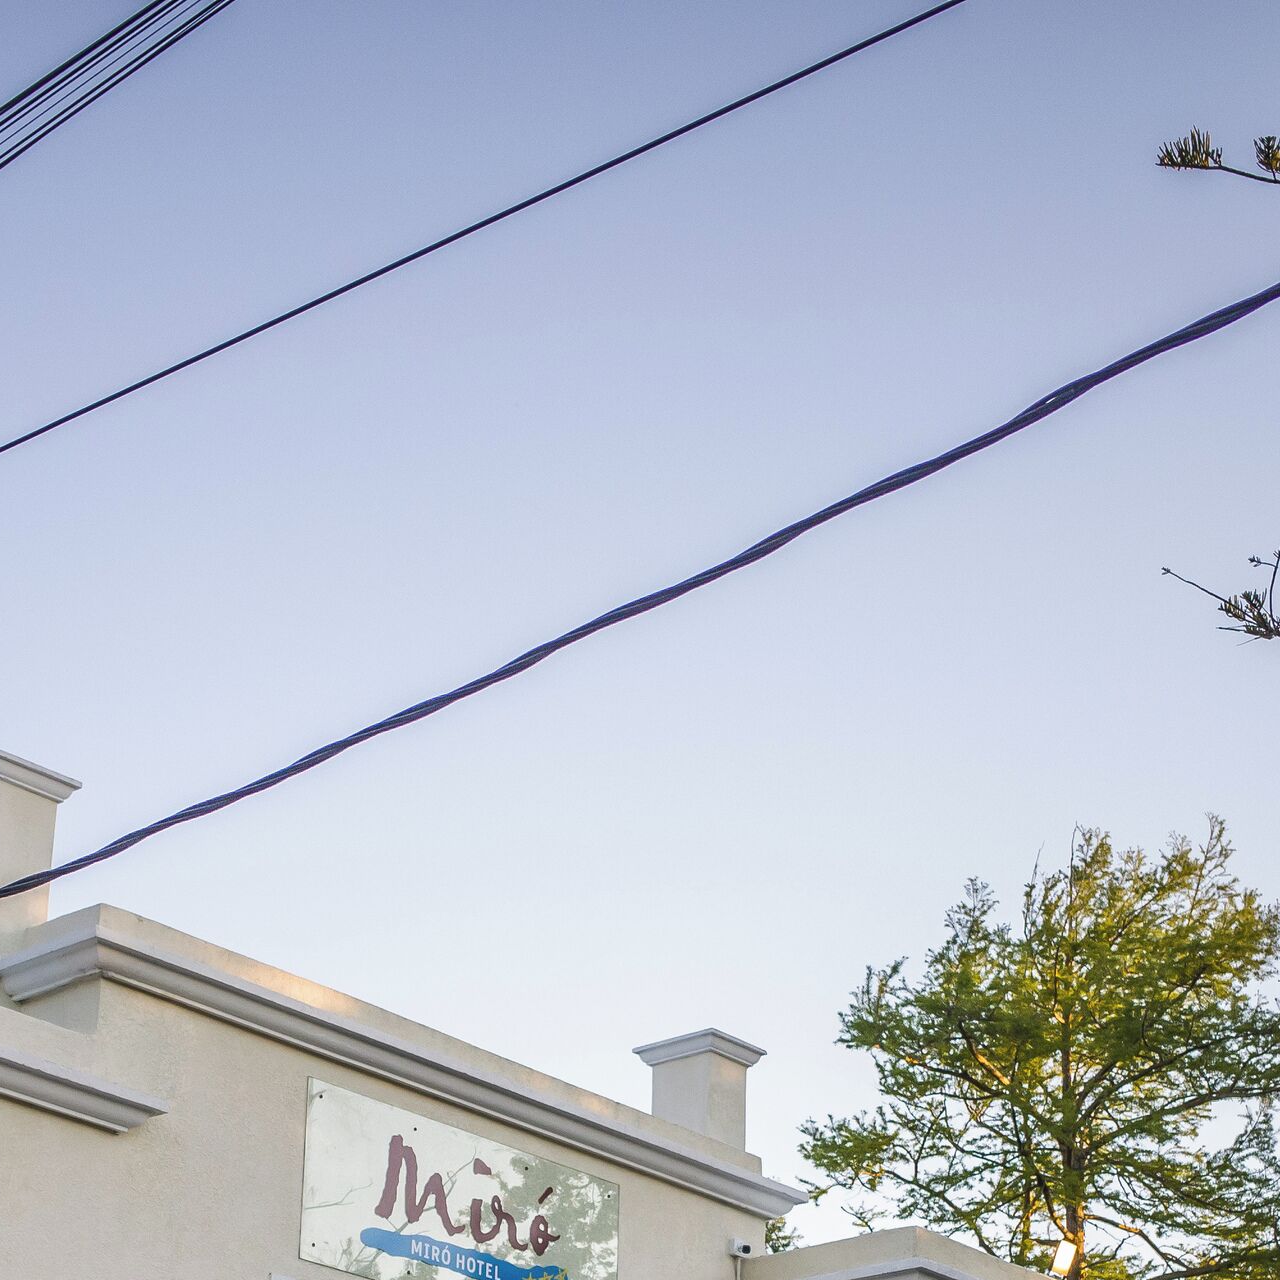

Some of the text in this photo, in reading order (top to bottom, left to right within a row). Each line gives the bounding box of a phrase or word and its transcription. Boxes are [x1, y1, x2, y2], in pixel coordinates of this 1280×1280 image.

[374, 1134, 561, 1256] Miró
[411, 1239, 501, 1280] MIRÓ HOTEL
